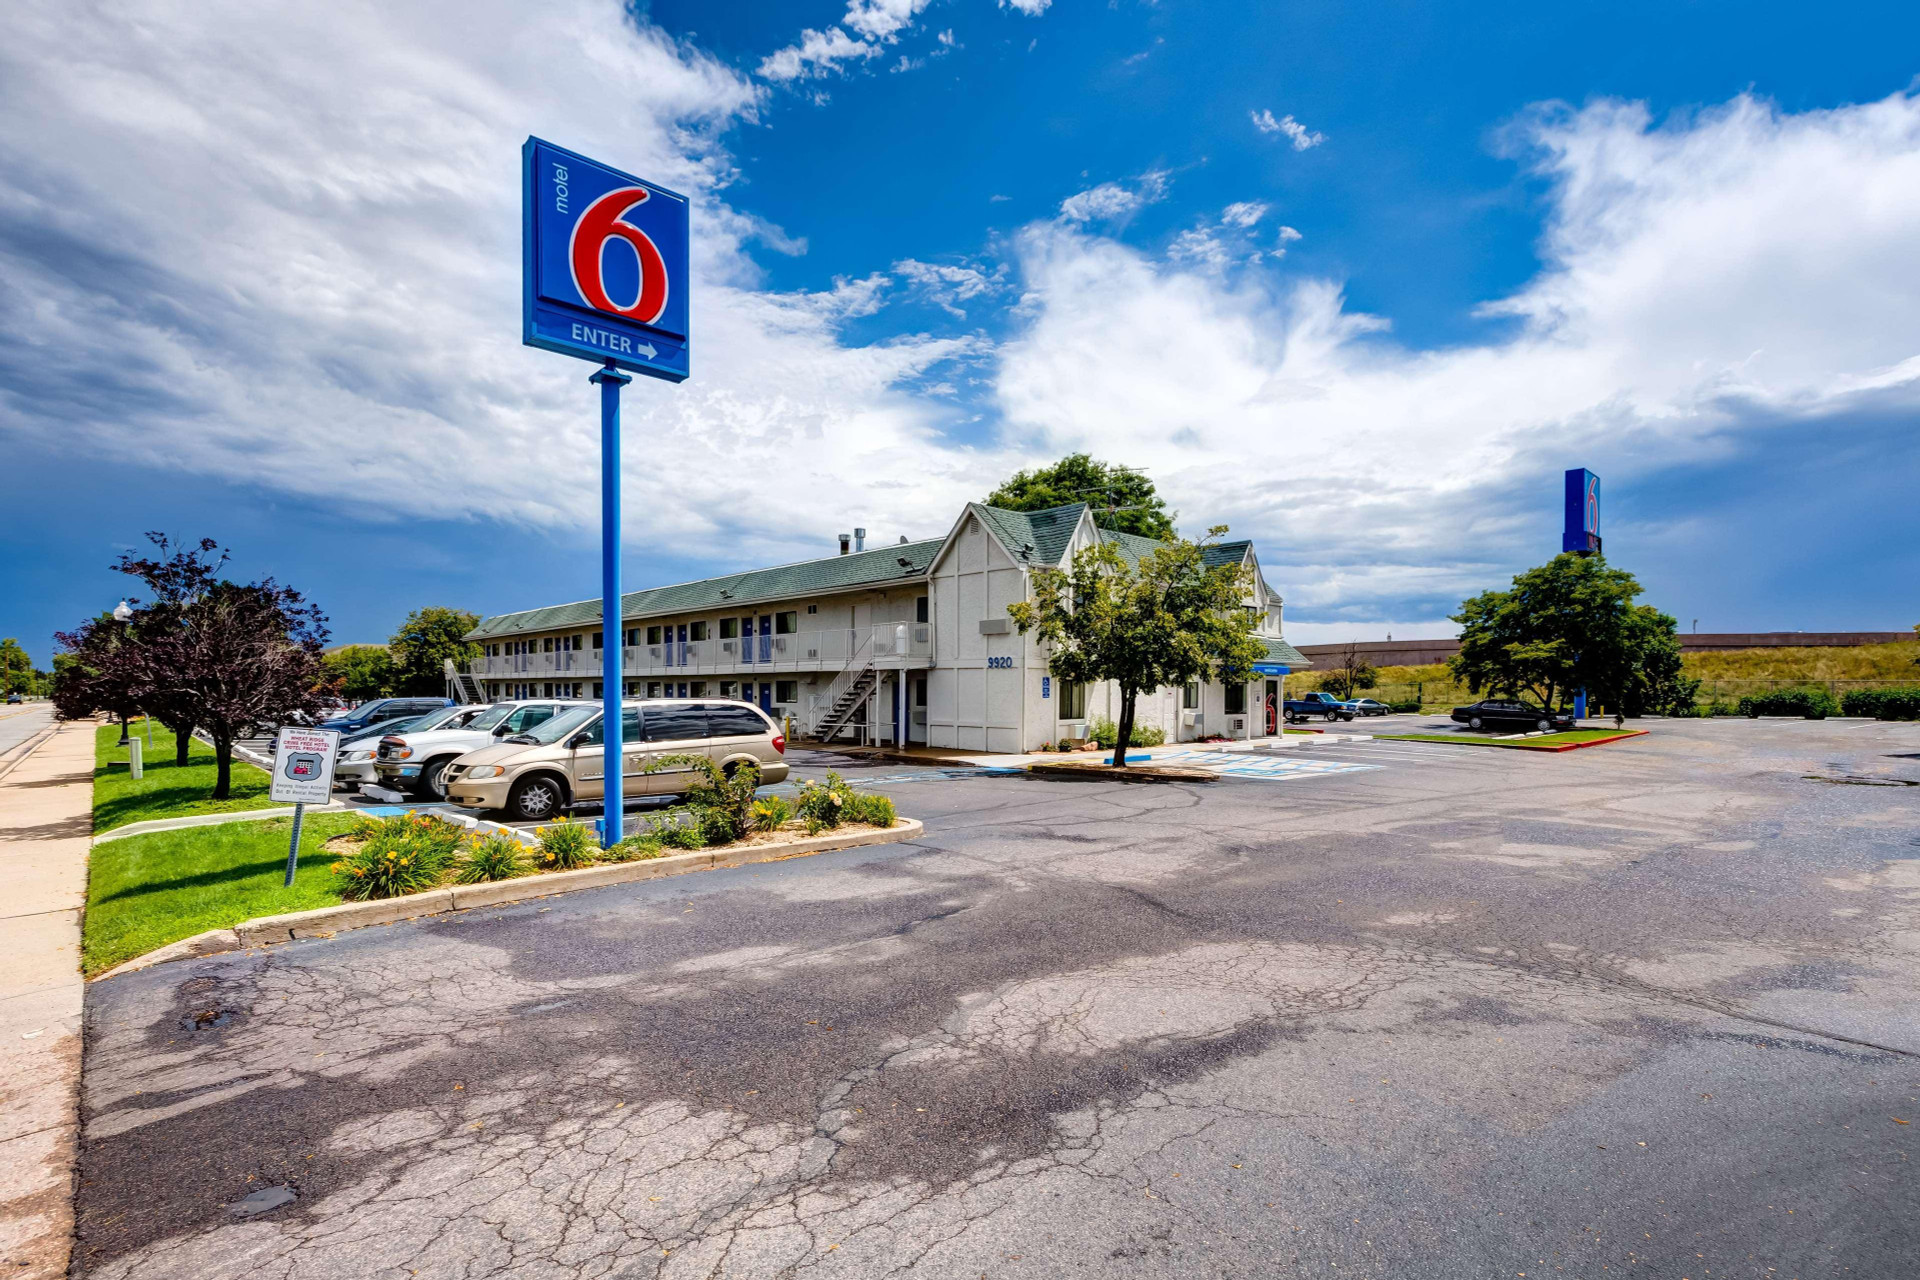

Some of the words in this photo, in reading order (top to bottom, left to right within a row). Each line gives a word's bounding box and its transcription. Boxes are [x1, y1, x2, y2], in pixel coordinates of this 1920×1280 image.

[552, 162, 569, 214] motel
[569, 185, 669, 326] 6
[571, 322, 632, 354] ENTER
[1587, 477, 1598, 535] 6
[987, 656, 1013, 669] 9920
